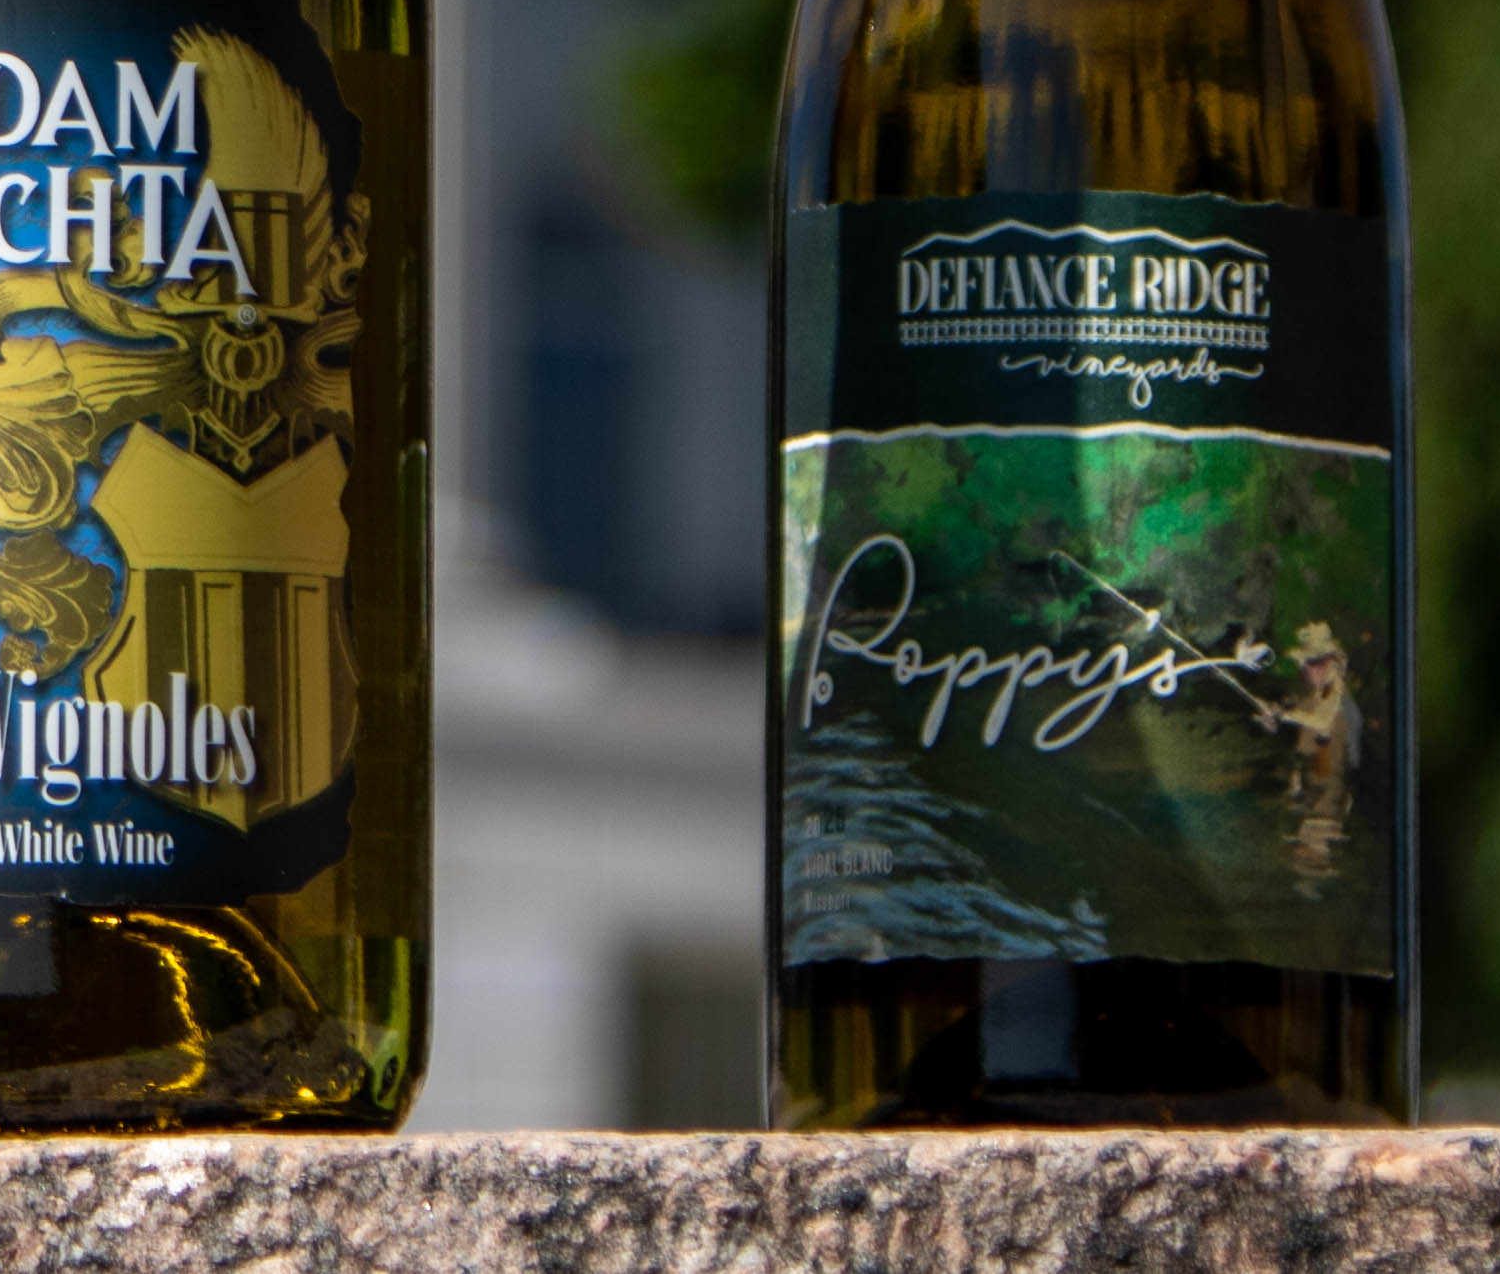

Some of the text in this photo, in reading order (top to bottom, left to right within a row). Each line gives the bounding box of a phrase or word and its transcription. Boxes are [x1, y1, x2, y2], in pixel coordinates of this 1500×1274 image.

[900, 254, 1271, 318] DEFIANCE RIDGE
[1001, 347, 1264, 409] vineyards
[91, 821, 175, 866] Wine
